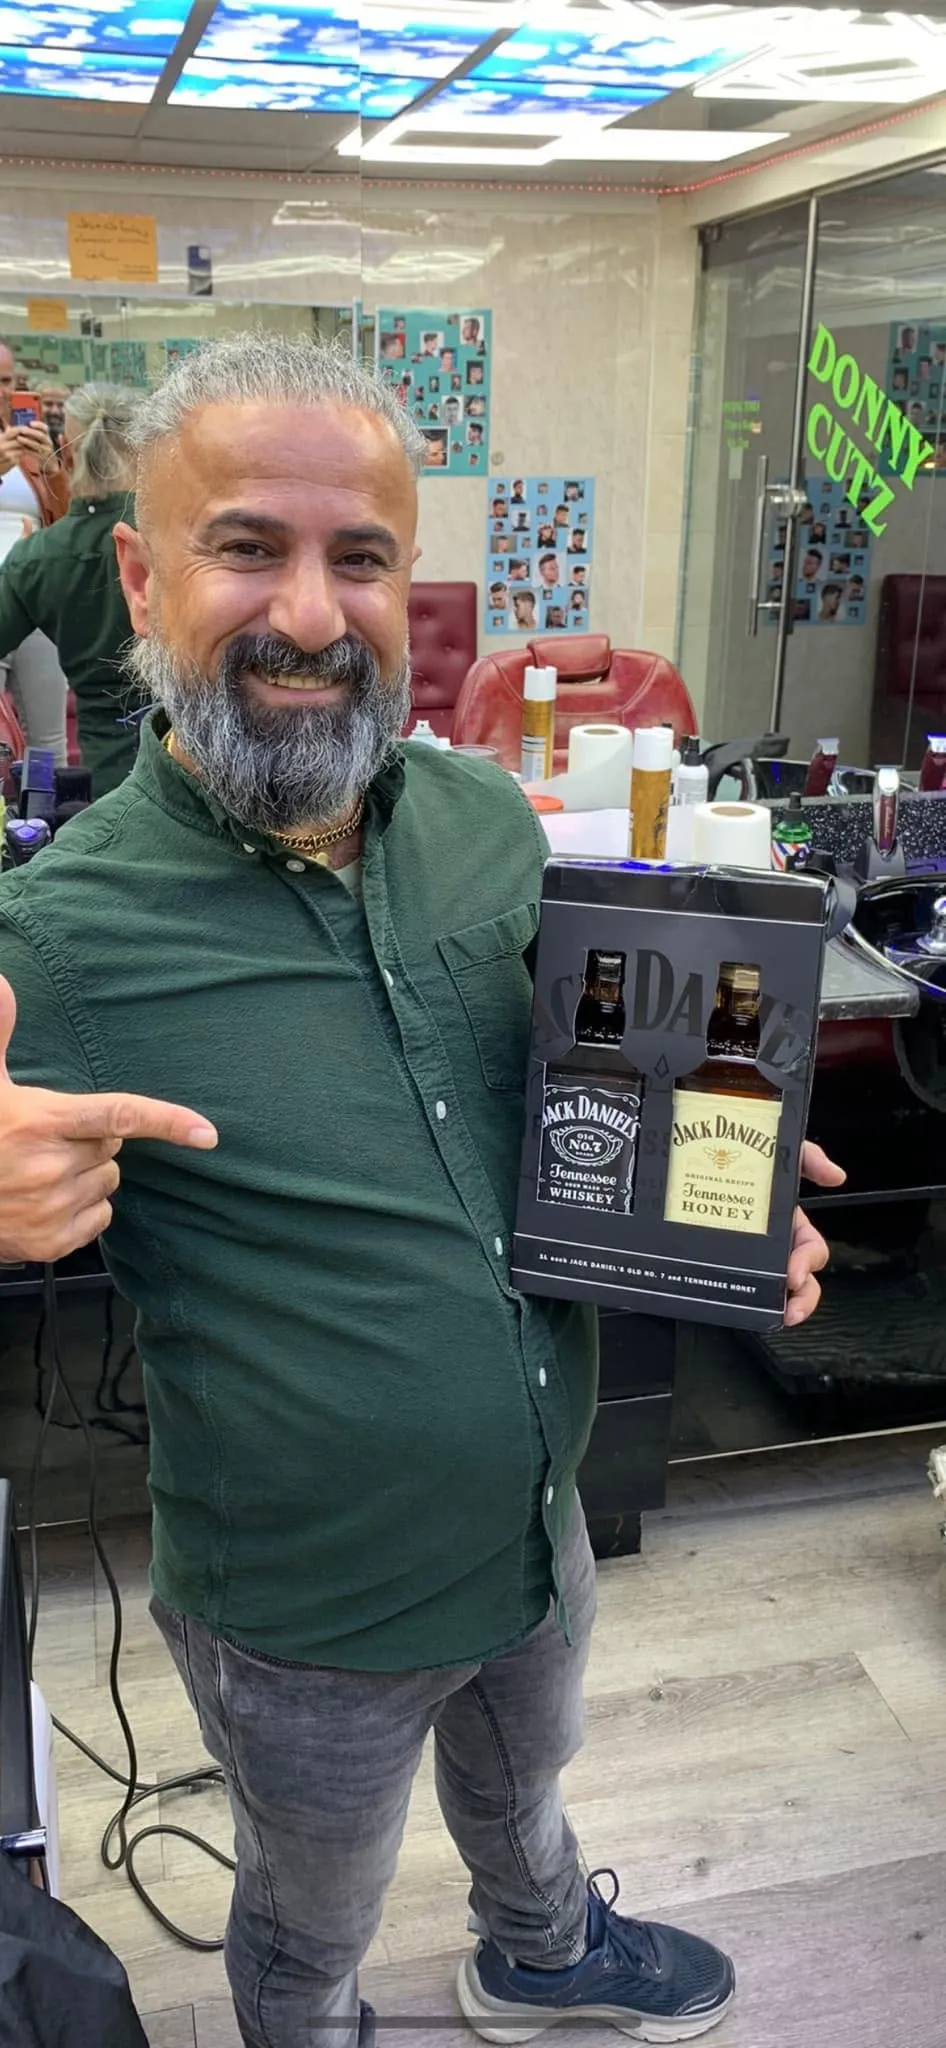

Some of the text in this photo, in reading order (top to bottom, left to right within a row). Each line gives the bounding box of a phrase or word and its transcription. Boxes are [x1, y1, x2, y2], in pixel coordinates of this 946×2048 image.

[807, 321, 935, 491] DONNY
[807, 403, 895, 537] CUTZ
[578, 1095, 641, 1142] DANIEL'S
[673, 1119, 712, 1147] JACK
[715, 1114, 777, 1158] DANIEL'S
[549, 1163, 617, 1186] Tennessee
[549, 1187, 615, 1205] WHISKEY
[681, 1200, 754, 1221] HONEY
[683, 1182, 755, 1206] Tennessee
[570, 1258, 588, 1268] JACK
[591, 1261, 625, 1273] DANIEL'S
[627, 1267, 642, 1276] OLD
[667, 1273, 682, 1282] and
[684, 1276, 728, 1290] TENNESSEE
[730, 1283, 757, 1294] HONEY
